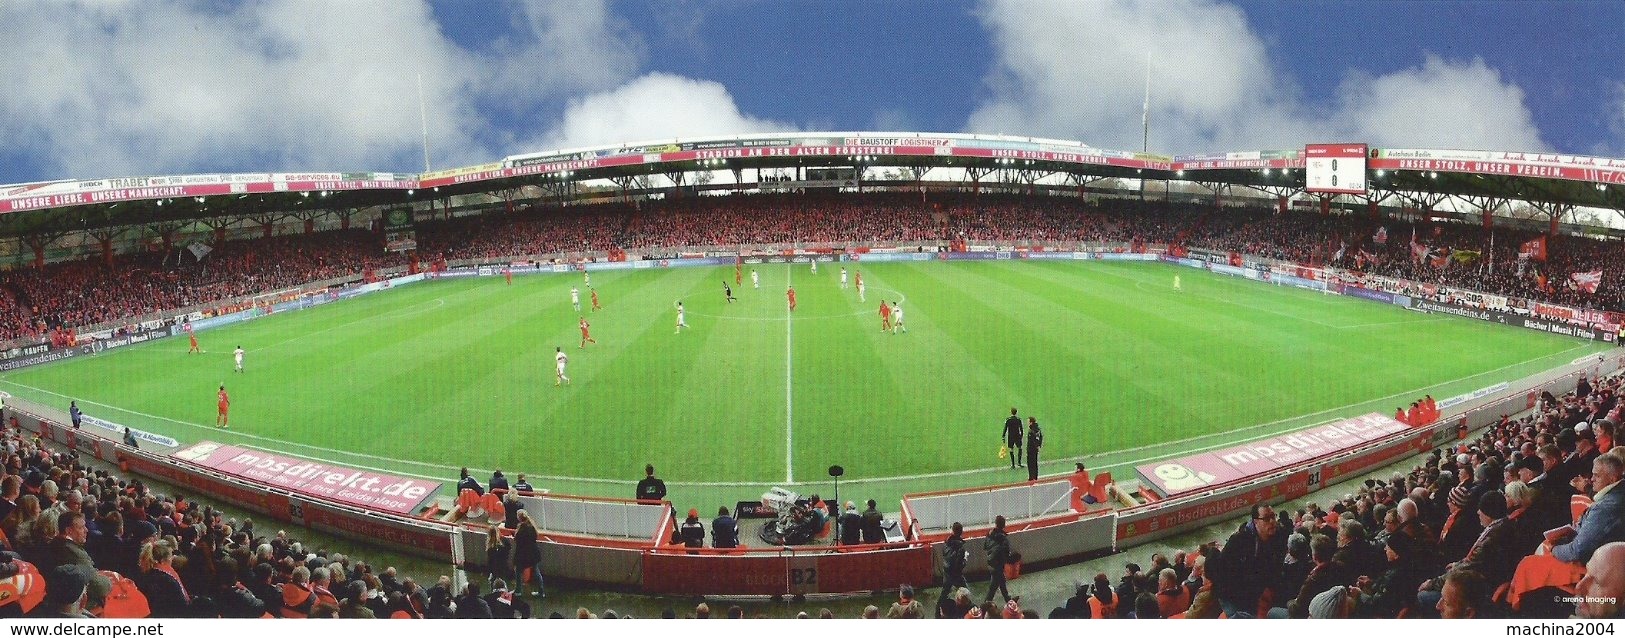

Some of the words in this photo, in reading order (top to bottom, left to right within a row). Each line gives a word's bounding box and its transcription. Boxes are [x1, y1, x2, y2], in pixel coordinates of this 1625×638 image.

[845, 138, 858, 146] DIE
[860, 138, 898, 146] BAUSTOFF
[900, 138, 942, 146] LOGISTIKER
[696, 149, 742, 159] STADION
[748, 148, 763, 157] AN
[769, 147, 790, 156] DER
[796, 146, 829, 156] ALTEN
[835, 146, 894, 155] FÖRSTEREI
[1053, 152, 1078, 162] UNSER
[1080, 154, 1110, 164] VEREIN.
[1415, 150, 1432, 158] Berlin
[454, 172, 481, 183] UNSERE
[511, 164, 541, 176] UNSERE
[545, 159, 601, 172] MANNSCHAFT.
[1332, 159, 1338, 171] 0
[1399, 160, 1431, 169] UNSER
[1475, 162, 1510, 173] UNSER
[1517, 165, 1564, 177] VEREIN.
[1332, 175, 1338, 187] 0
[11, 196, 52, 210] UNSERE
[91, 189, 127, 204] UNSERE
[129, 186, 187, 200] MANNSCHAFT.
[1416, 300, 1490, 321] Zweitausendeins.de
[1524, 319, 1548, 331] Bücher
[1551, 324, 1573, 335] Musik
[1576, 328, 1596, 339] Filme
[106, 339, 127, 349] Bücher
[1165, 498, 1244, 526] mbsdirekt.de
[791, 568, 817, 585] B2
